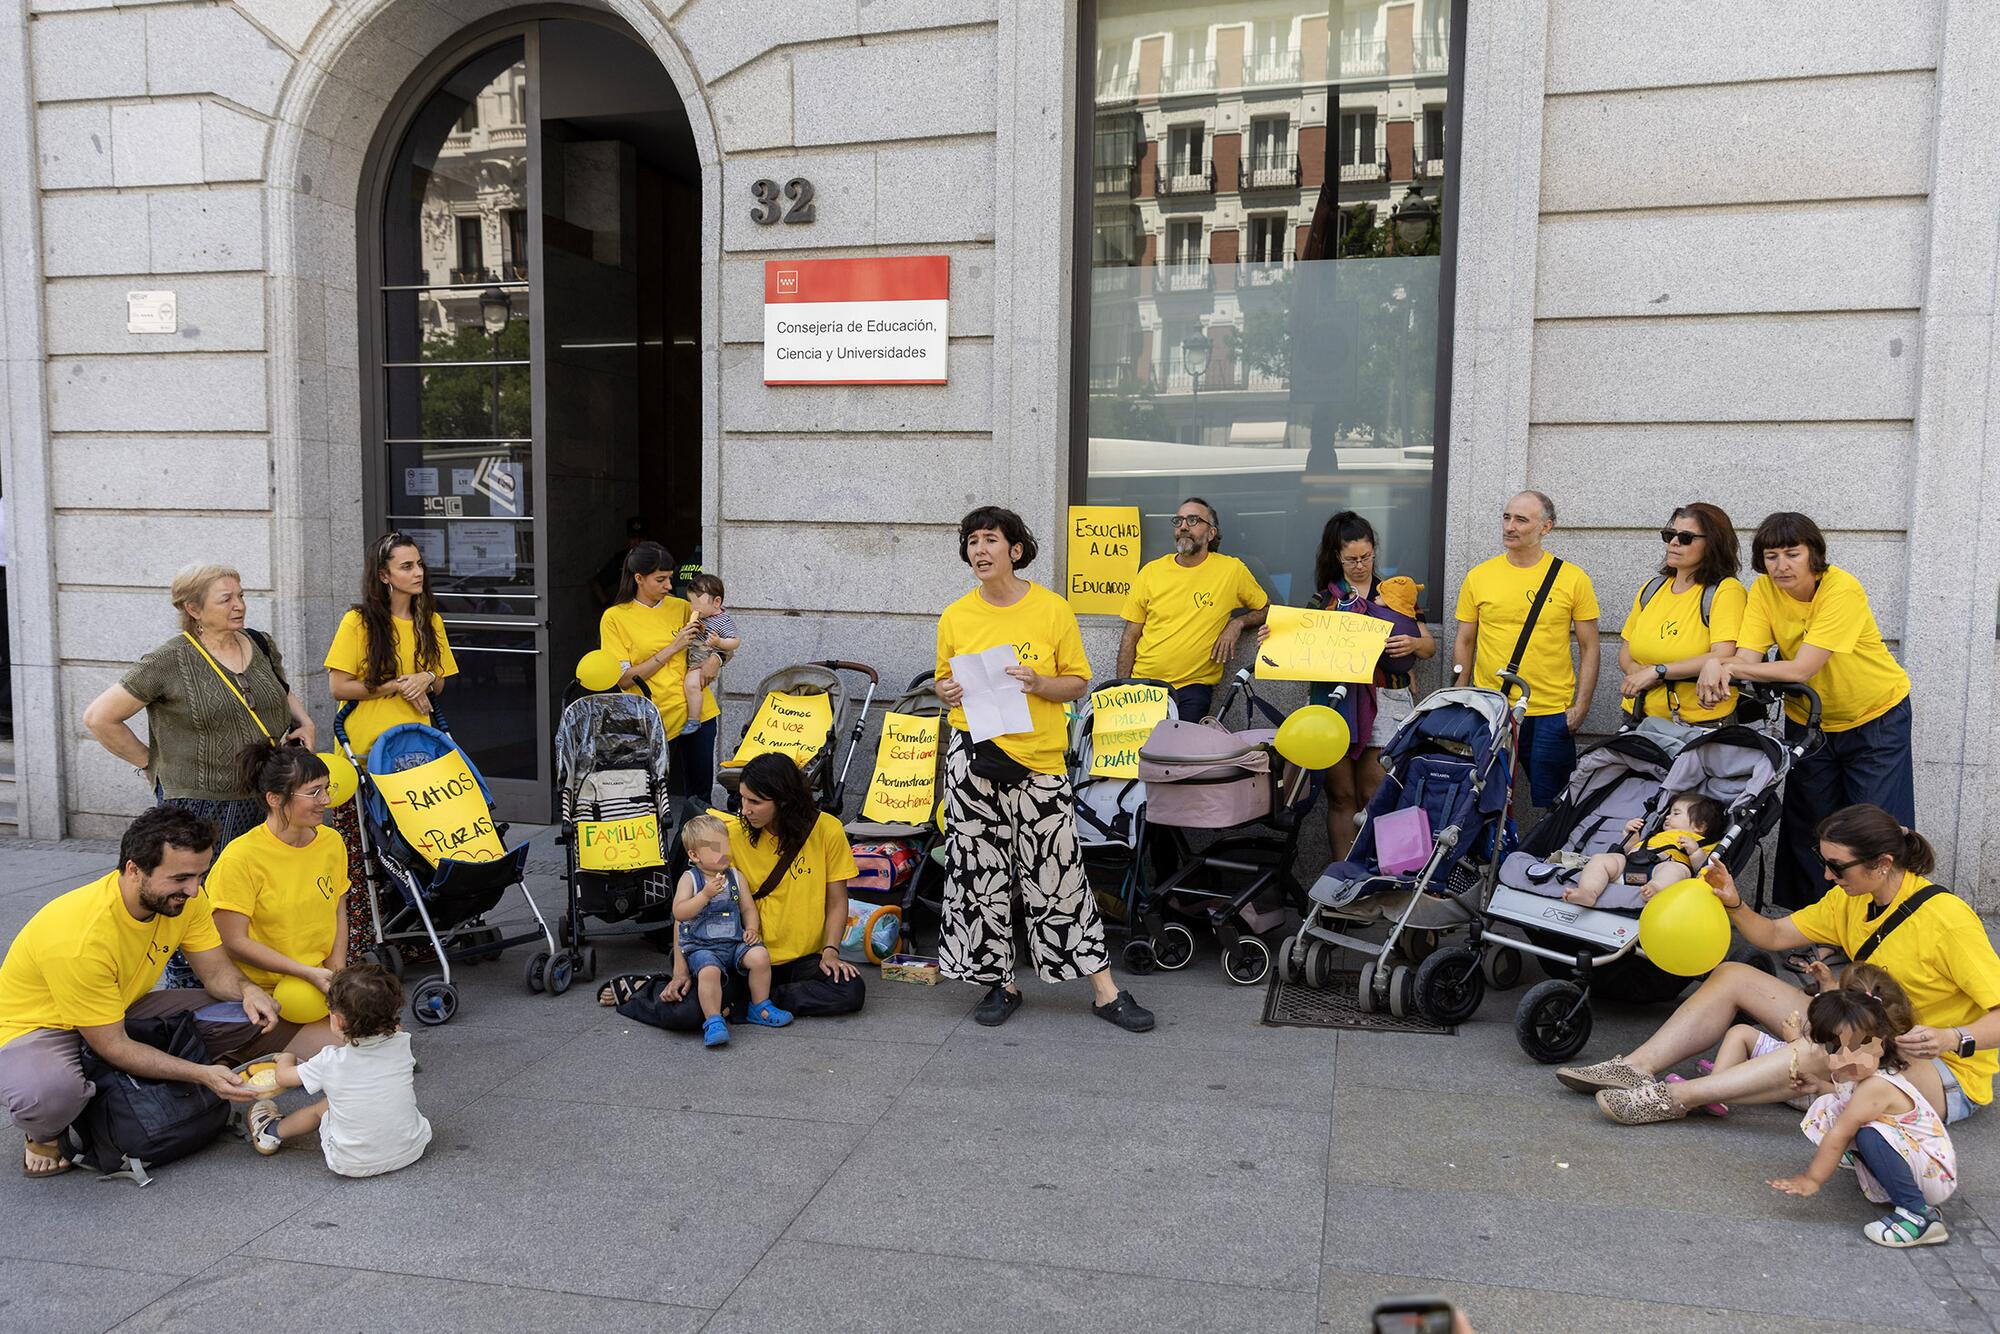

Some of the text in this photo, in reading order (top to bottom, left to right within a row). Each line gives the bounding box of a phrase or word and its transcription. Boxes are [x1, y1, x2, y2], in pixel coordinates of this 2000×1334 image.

[750, 177, 816, 225] 32
[777, 319, 937, 336] Consejería de Educación,
[777, 346, 927, 362] Ciencia y Universidades
[1076, 518, 1139, 538] ESCUCHAD
[1090, 542, 1129, 556] A LAS
[1300, 613, 1331, 630] SIN
[1295, 632, 1357, 647] NO NOS
[753, 732, 766, 745] de
[604, 843, 640, 861] 0-3
